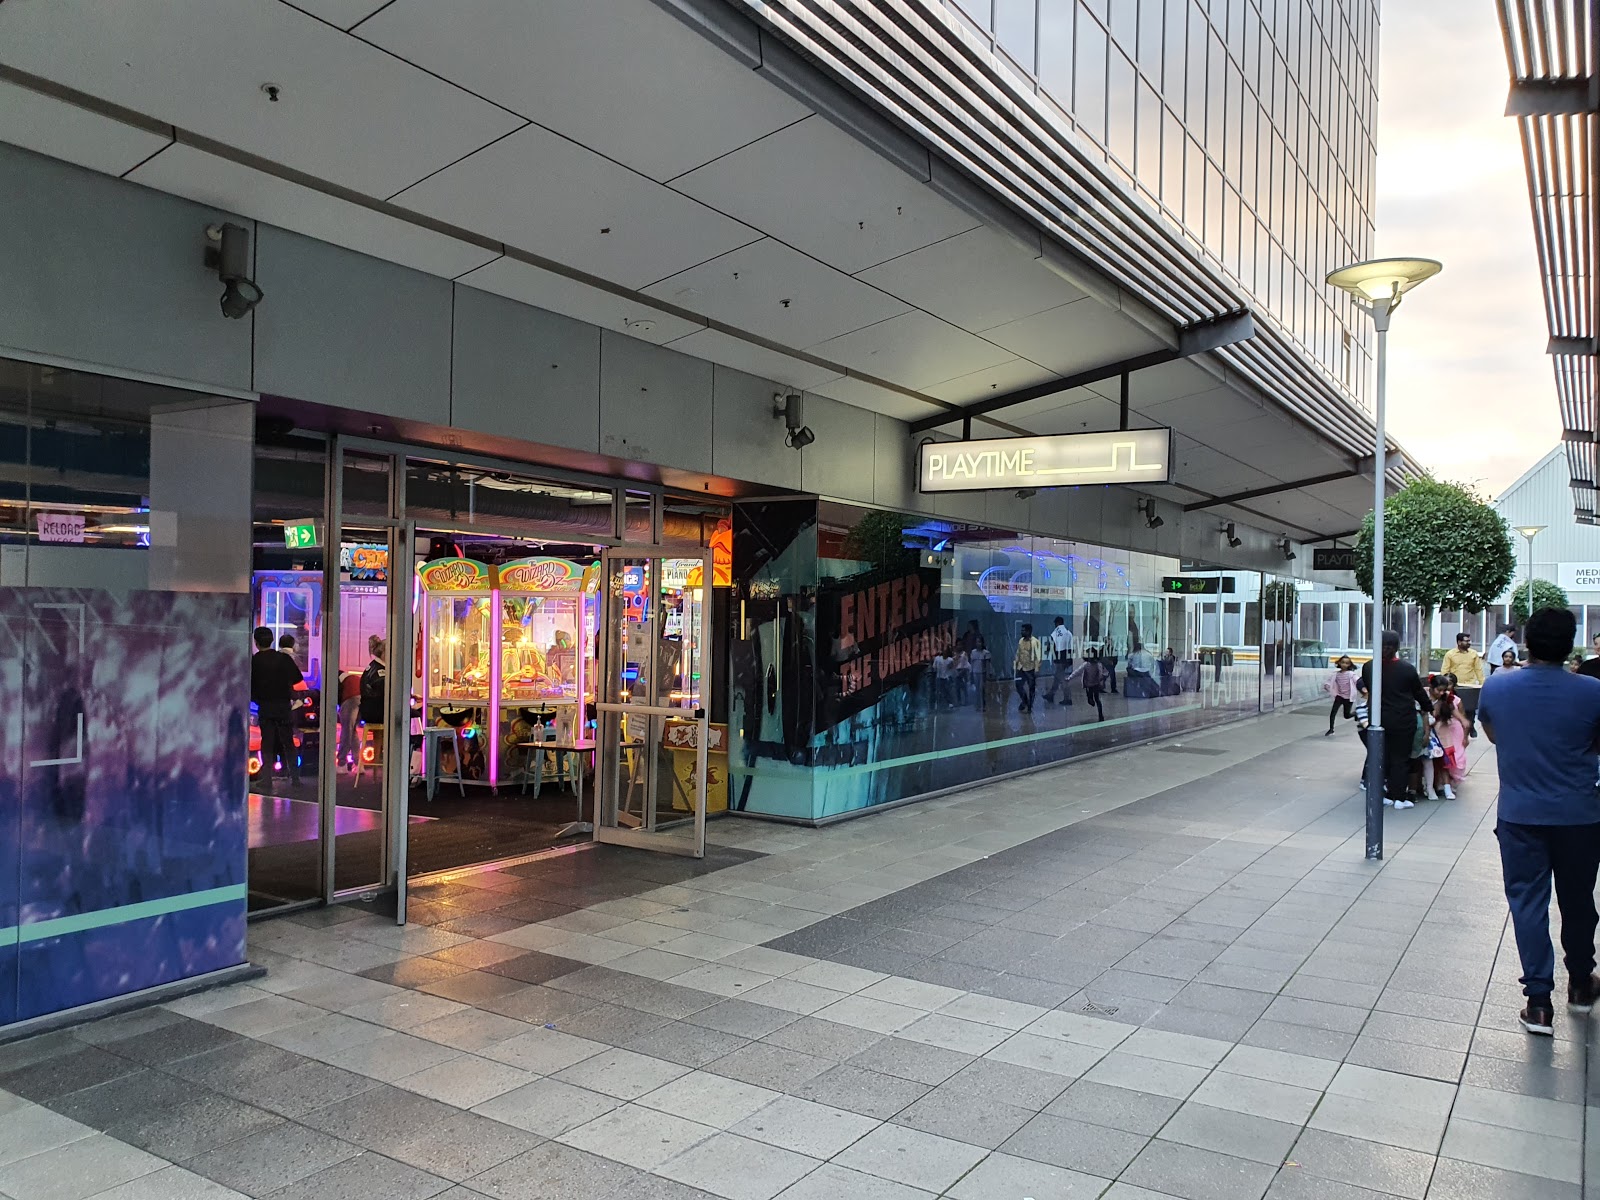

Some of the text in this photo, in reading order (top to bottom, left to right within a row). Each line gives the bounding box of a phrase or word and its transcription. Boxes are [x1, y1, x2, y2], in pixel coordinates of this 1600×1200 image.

[929, 449, 1035, 480] PLAYTIME
[43, 522, 81, 536] RELOAD
[434, 561, 465, 584] WIZARD
[516, 561, 555, 583] WIZARD
[840, 573, 928, 650] ENTER:
[840, 653, 872, 697] THE
